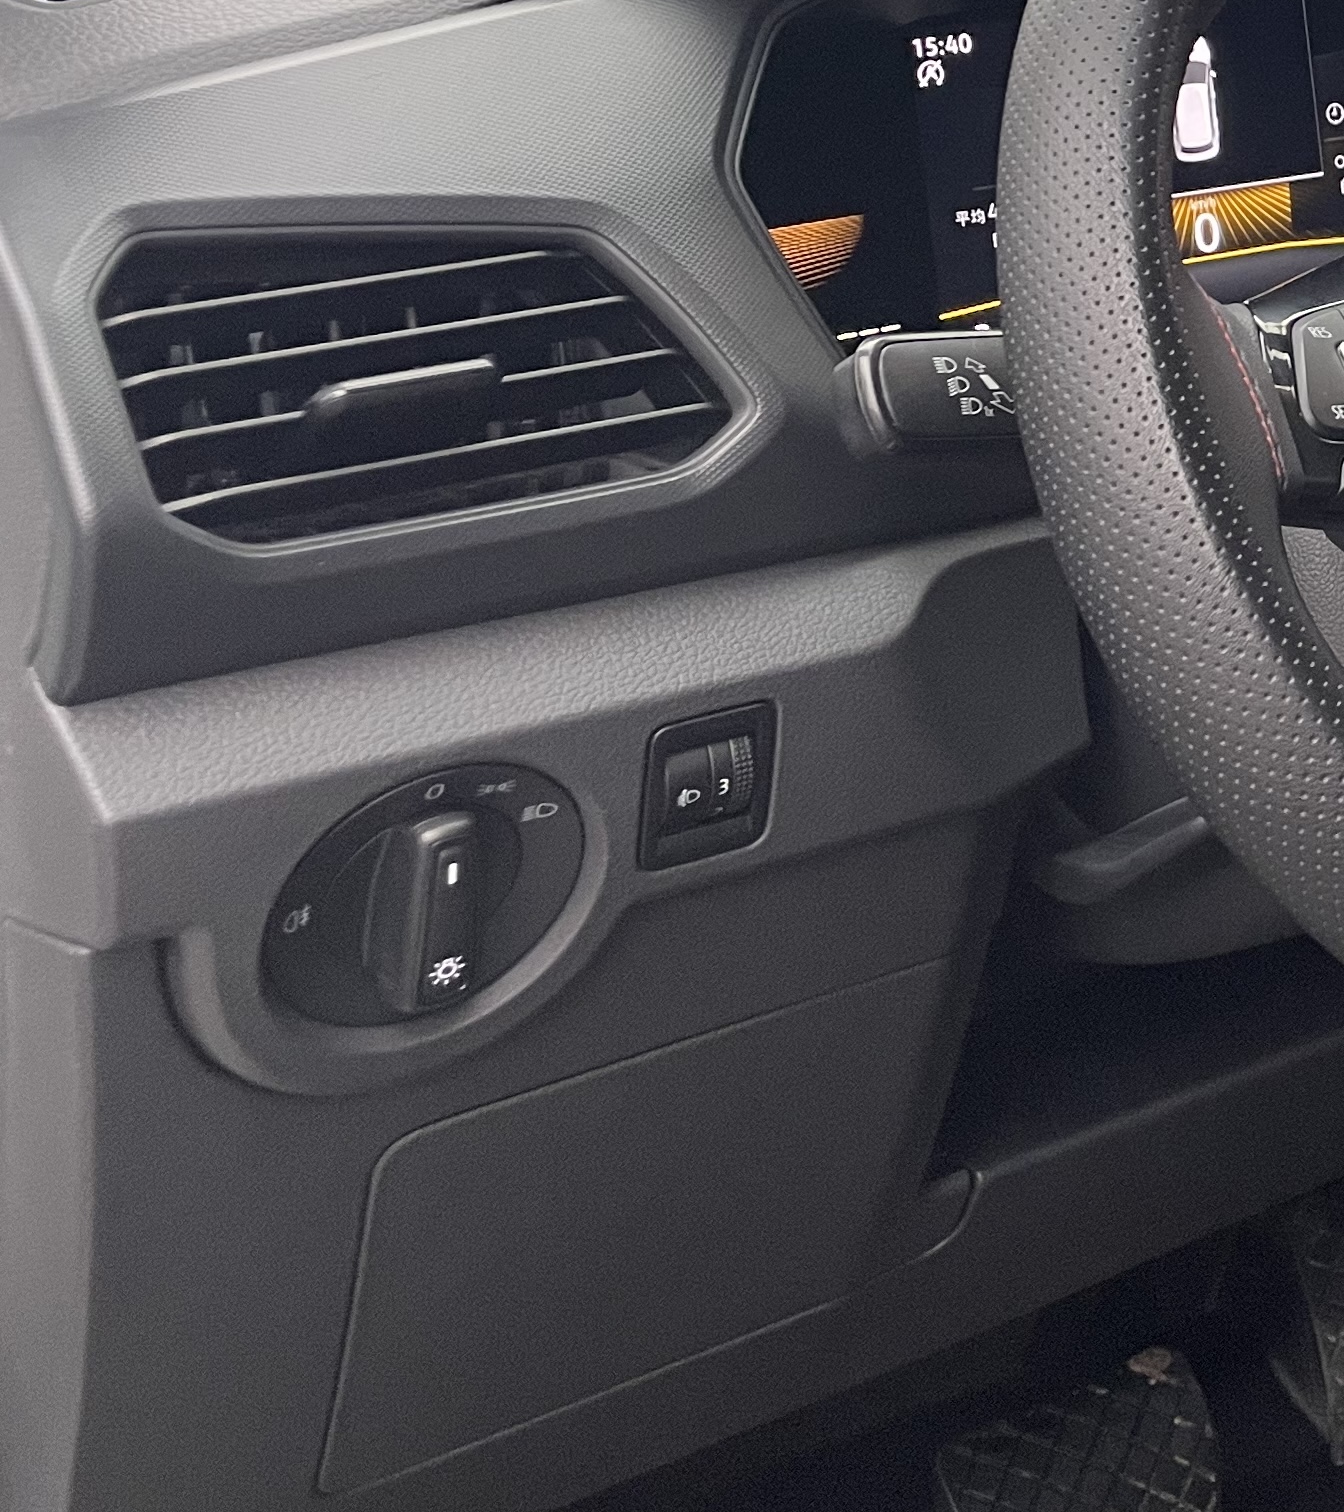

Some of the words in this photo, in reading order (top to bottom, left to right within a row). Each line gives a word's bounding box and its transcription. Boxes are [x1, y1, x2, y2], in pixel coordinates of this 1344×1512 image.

[911, 32, 973, 58] 15:40
[955, 207, 987, 228] 平均
[1194, 211, 1220, 254] 0
[1307, 326, 1332, 339] RES
